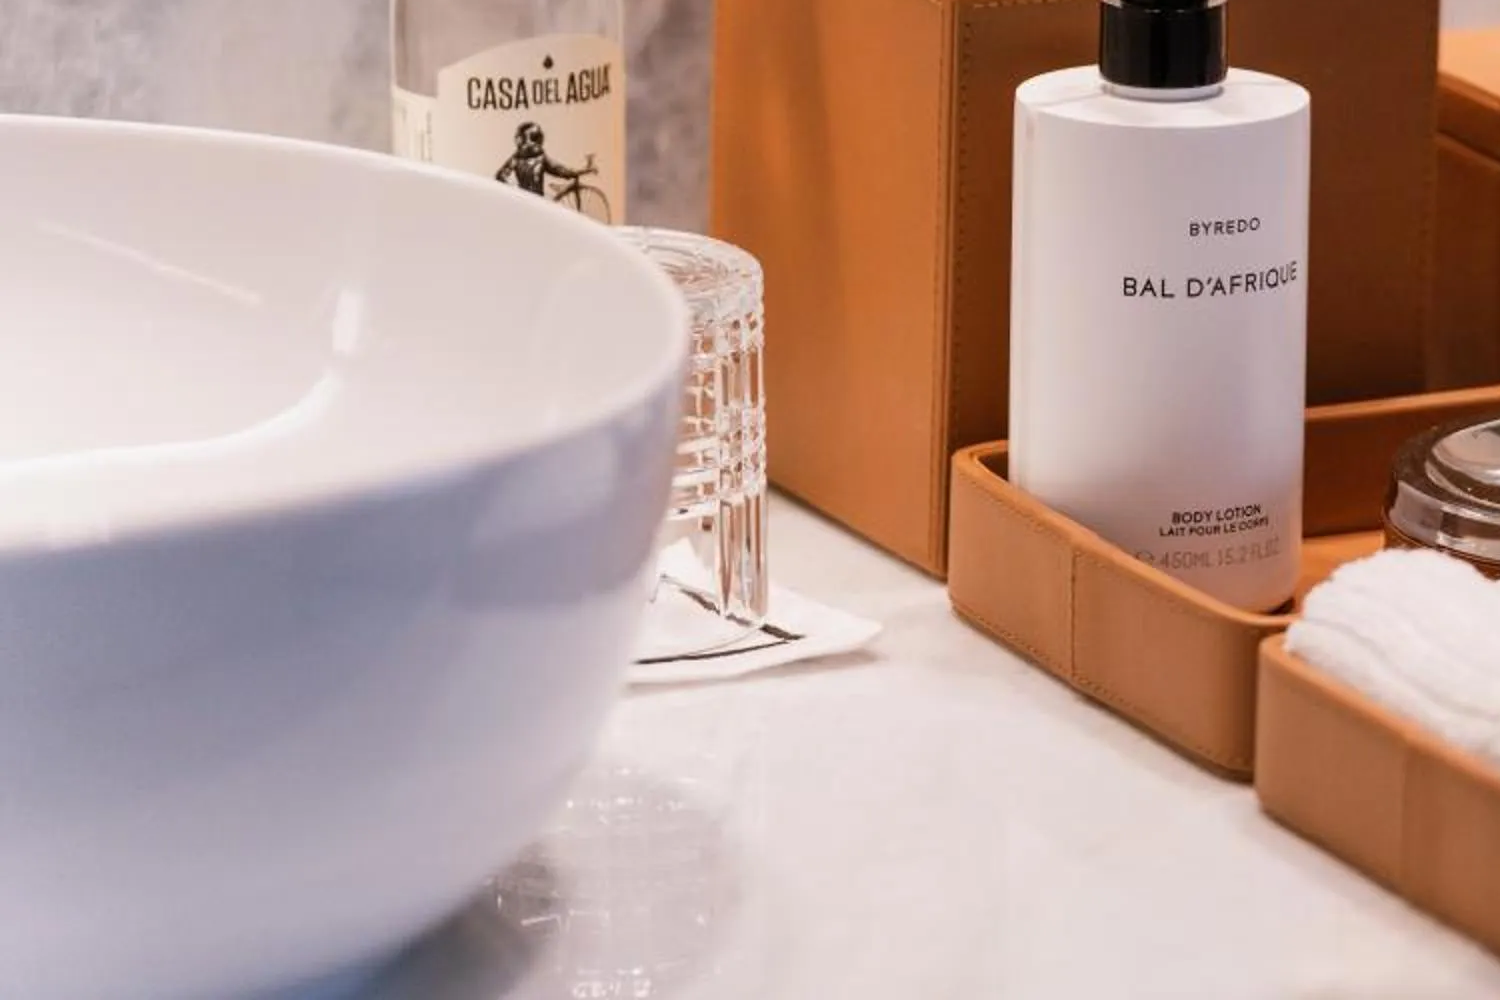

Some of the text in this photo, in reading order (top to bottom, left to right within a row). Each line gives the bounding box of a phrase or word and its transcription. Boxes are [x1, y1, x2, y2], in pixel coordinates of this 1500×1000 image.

[467, 63, 612, 111] CASA DEL AGUA
[1189, 217, 1261, 237] BYREDO
[1122, 260, 1298, 298] BAL D'AFRIQUE
[1171, 504, 1262, 524] BODY LOTION
[1159, 526, 1185, 537] LAIT
[1188, 524, 1221, 537] POUR
[1223, 522, 1237, 534] LE
